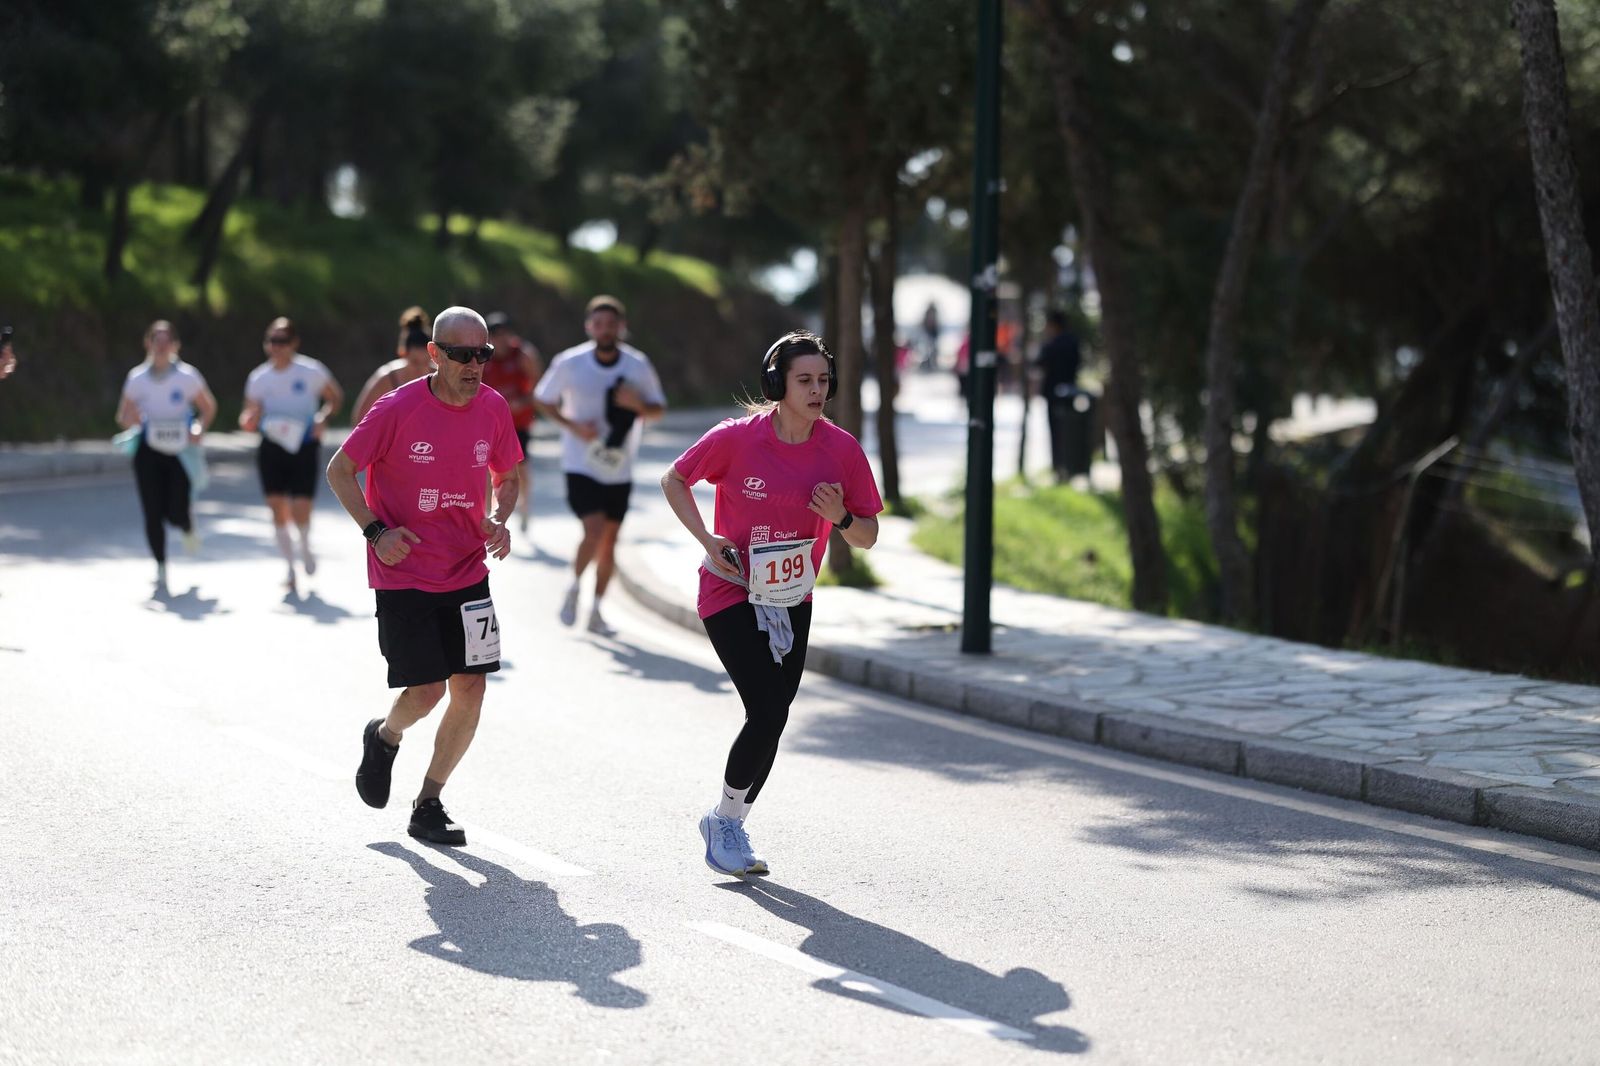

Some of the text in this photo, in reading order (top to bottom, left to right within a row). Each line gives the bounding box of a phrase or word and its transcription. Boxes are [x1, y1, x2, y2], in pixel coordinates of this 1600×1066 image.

[441, 492, 466, 500] Ciudad
[741, 489, 768, 499] HYUNDAI
[774, 531, 798, 539] Ciudad
[765, 553, 804, 585] 199
[476, 614, 499, 640] 74
